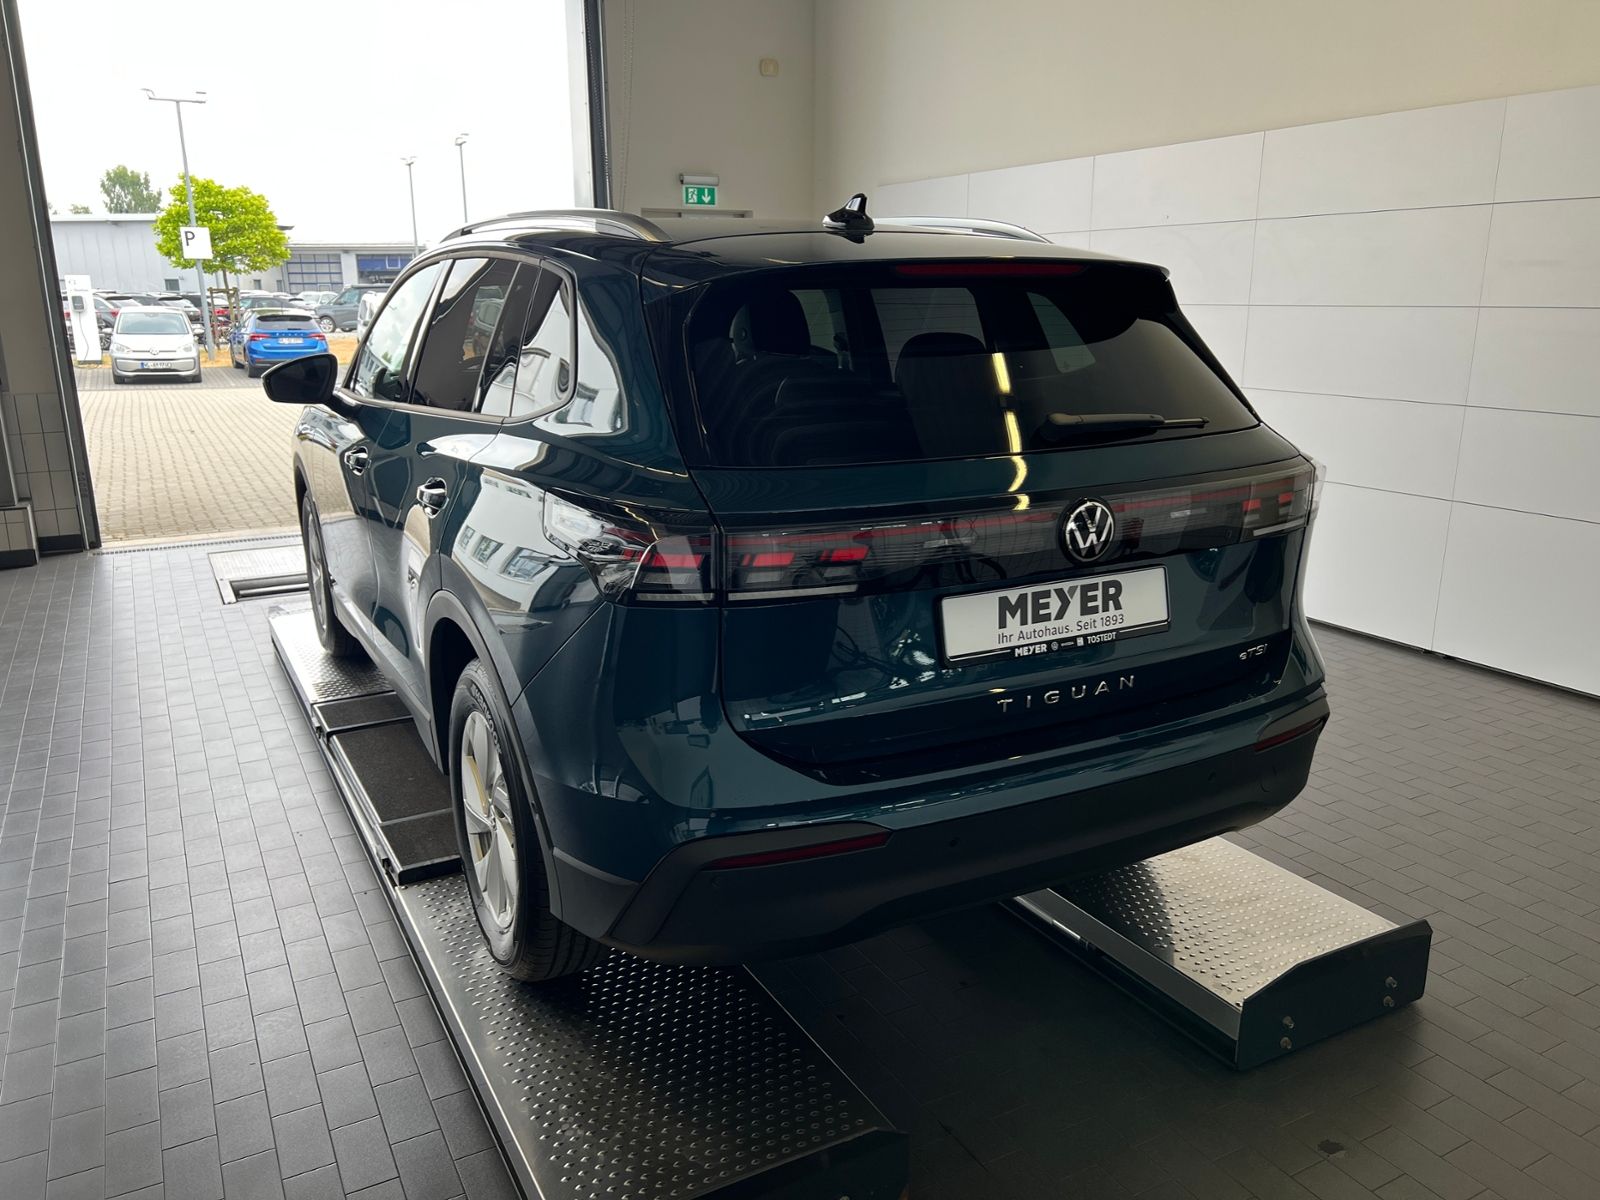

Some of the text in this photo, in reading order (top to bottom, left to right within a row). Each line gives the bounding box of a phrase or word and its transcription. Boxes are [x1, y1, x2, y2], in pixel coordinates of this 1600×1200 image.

[184, 230, 196, 247] P
[998, 579, 1123, 630] MEYER
[998, 613, 1125, 645] Ihr Autohaus. Seit 1893
[1014, 631, 1117, 658] MEYER TOSTEDT
[997, 675, 1135, 713] TIGUAN
